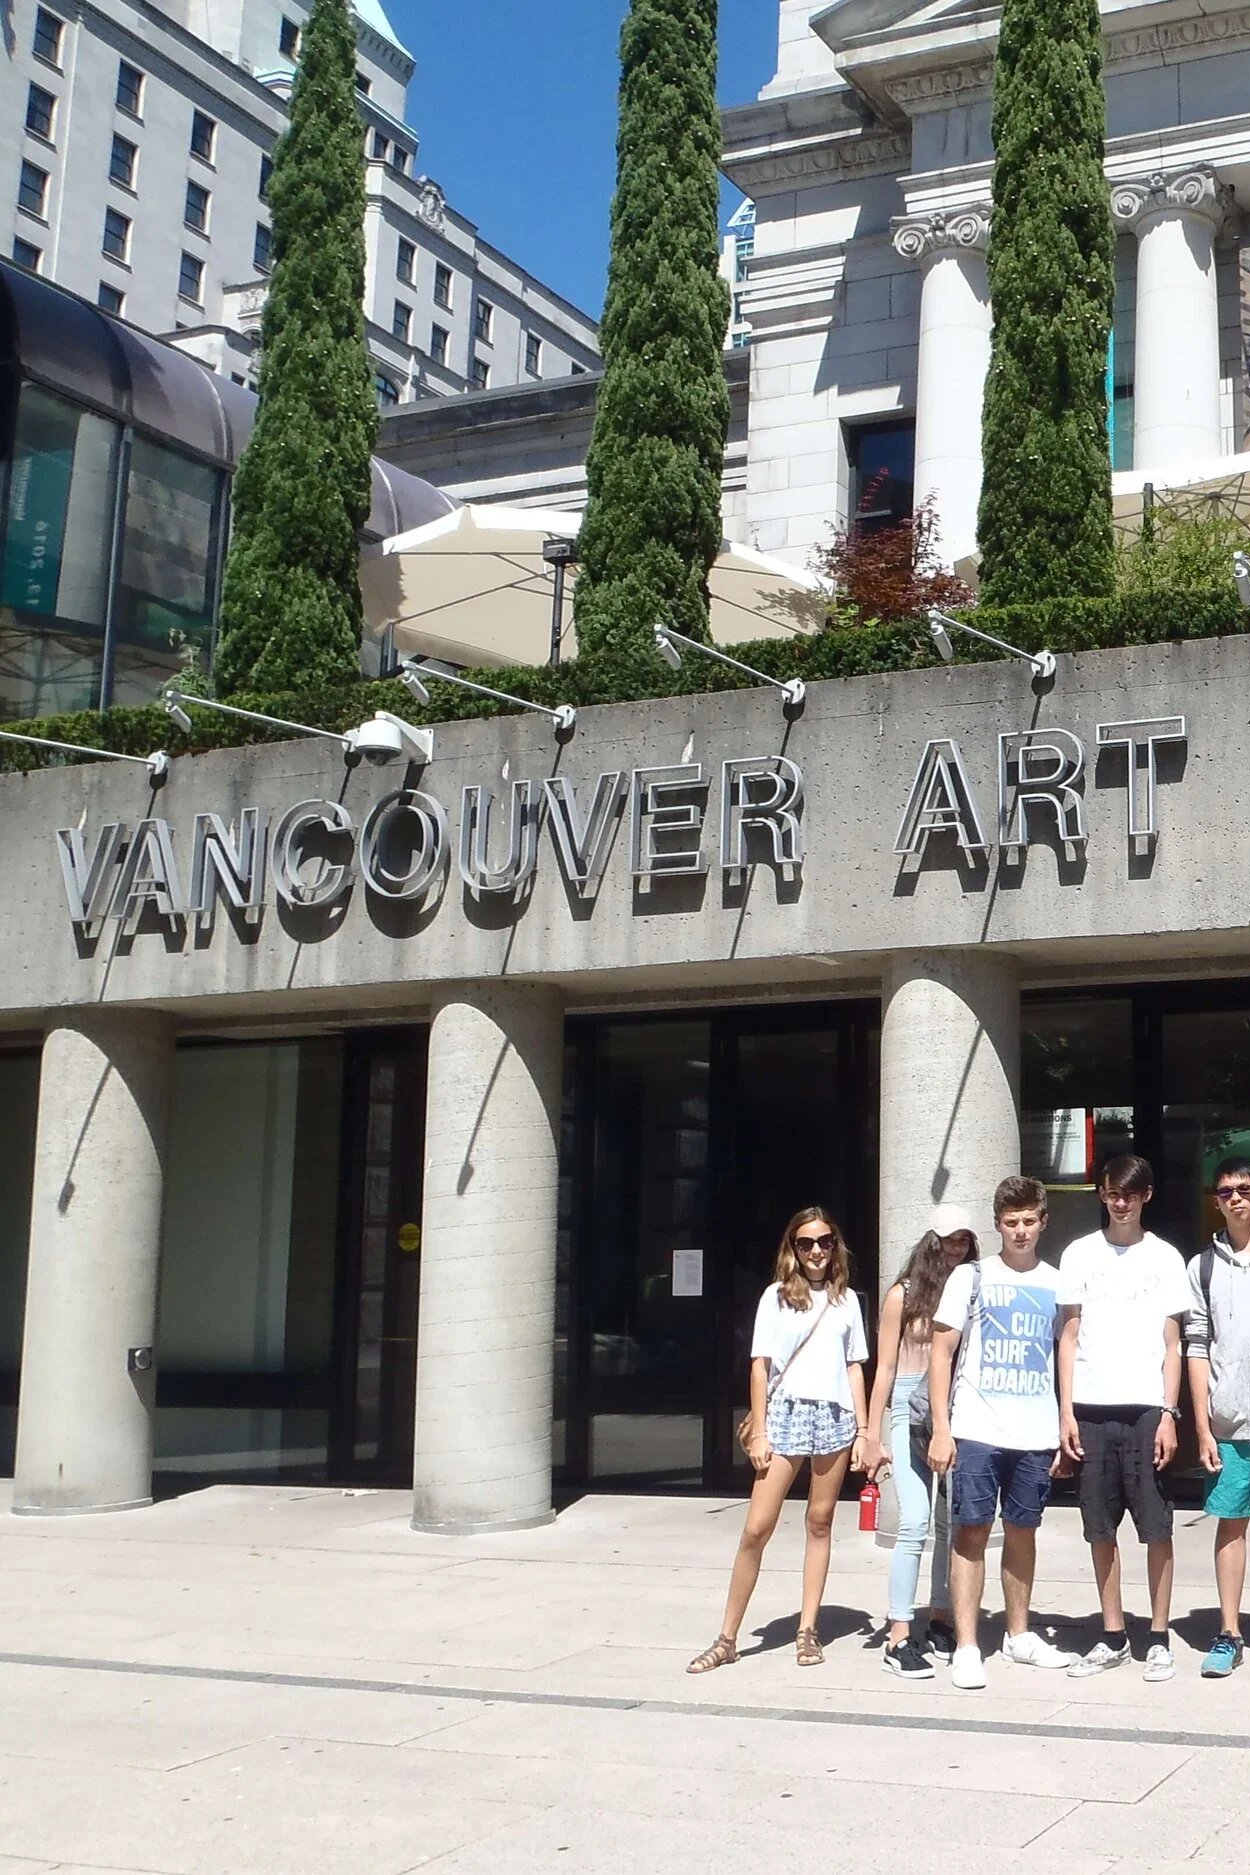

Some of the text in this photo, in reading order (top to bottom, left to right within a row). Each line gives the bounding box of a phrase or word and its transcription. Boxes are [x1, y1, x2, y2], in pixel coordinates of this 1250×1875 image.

[56, 754, 806, 924] VANCOUVER
[893, 714, 1189, 855] ART
[982, 1285, 1017, 1308] RIP
[983, 1339, 1032, 1364] SURF
[980, 1366, 1052, 1396] BOARDS
